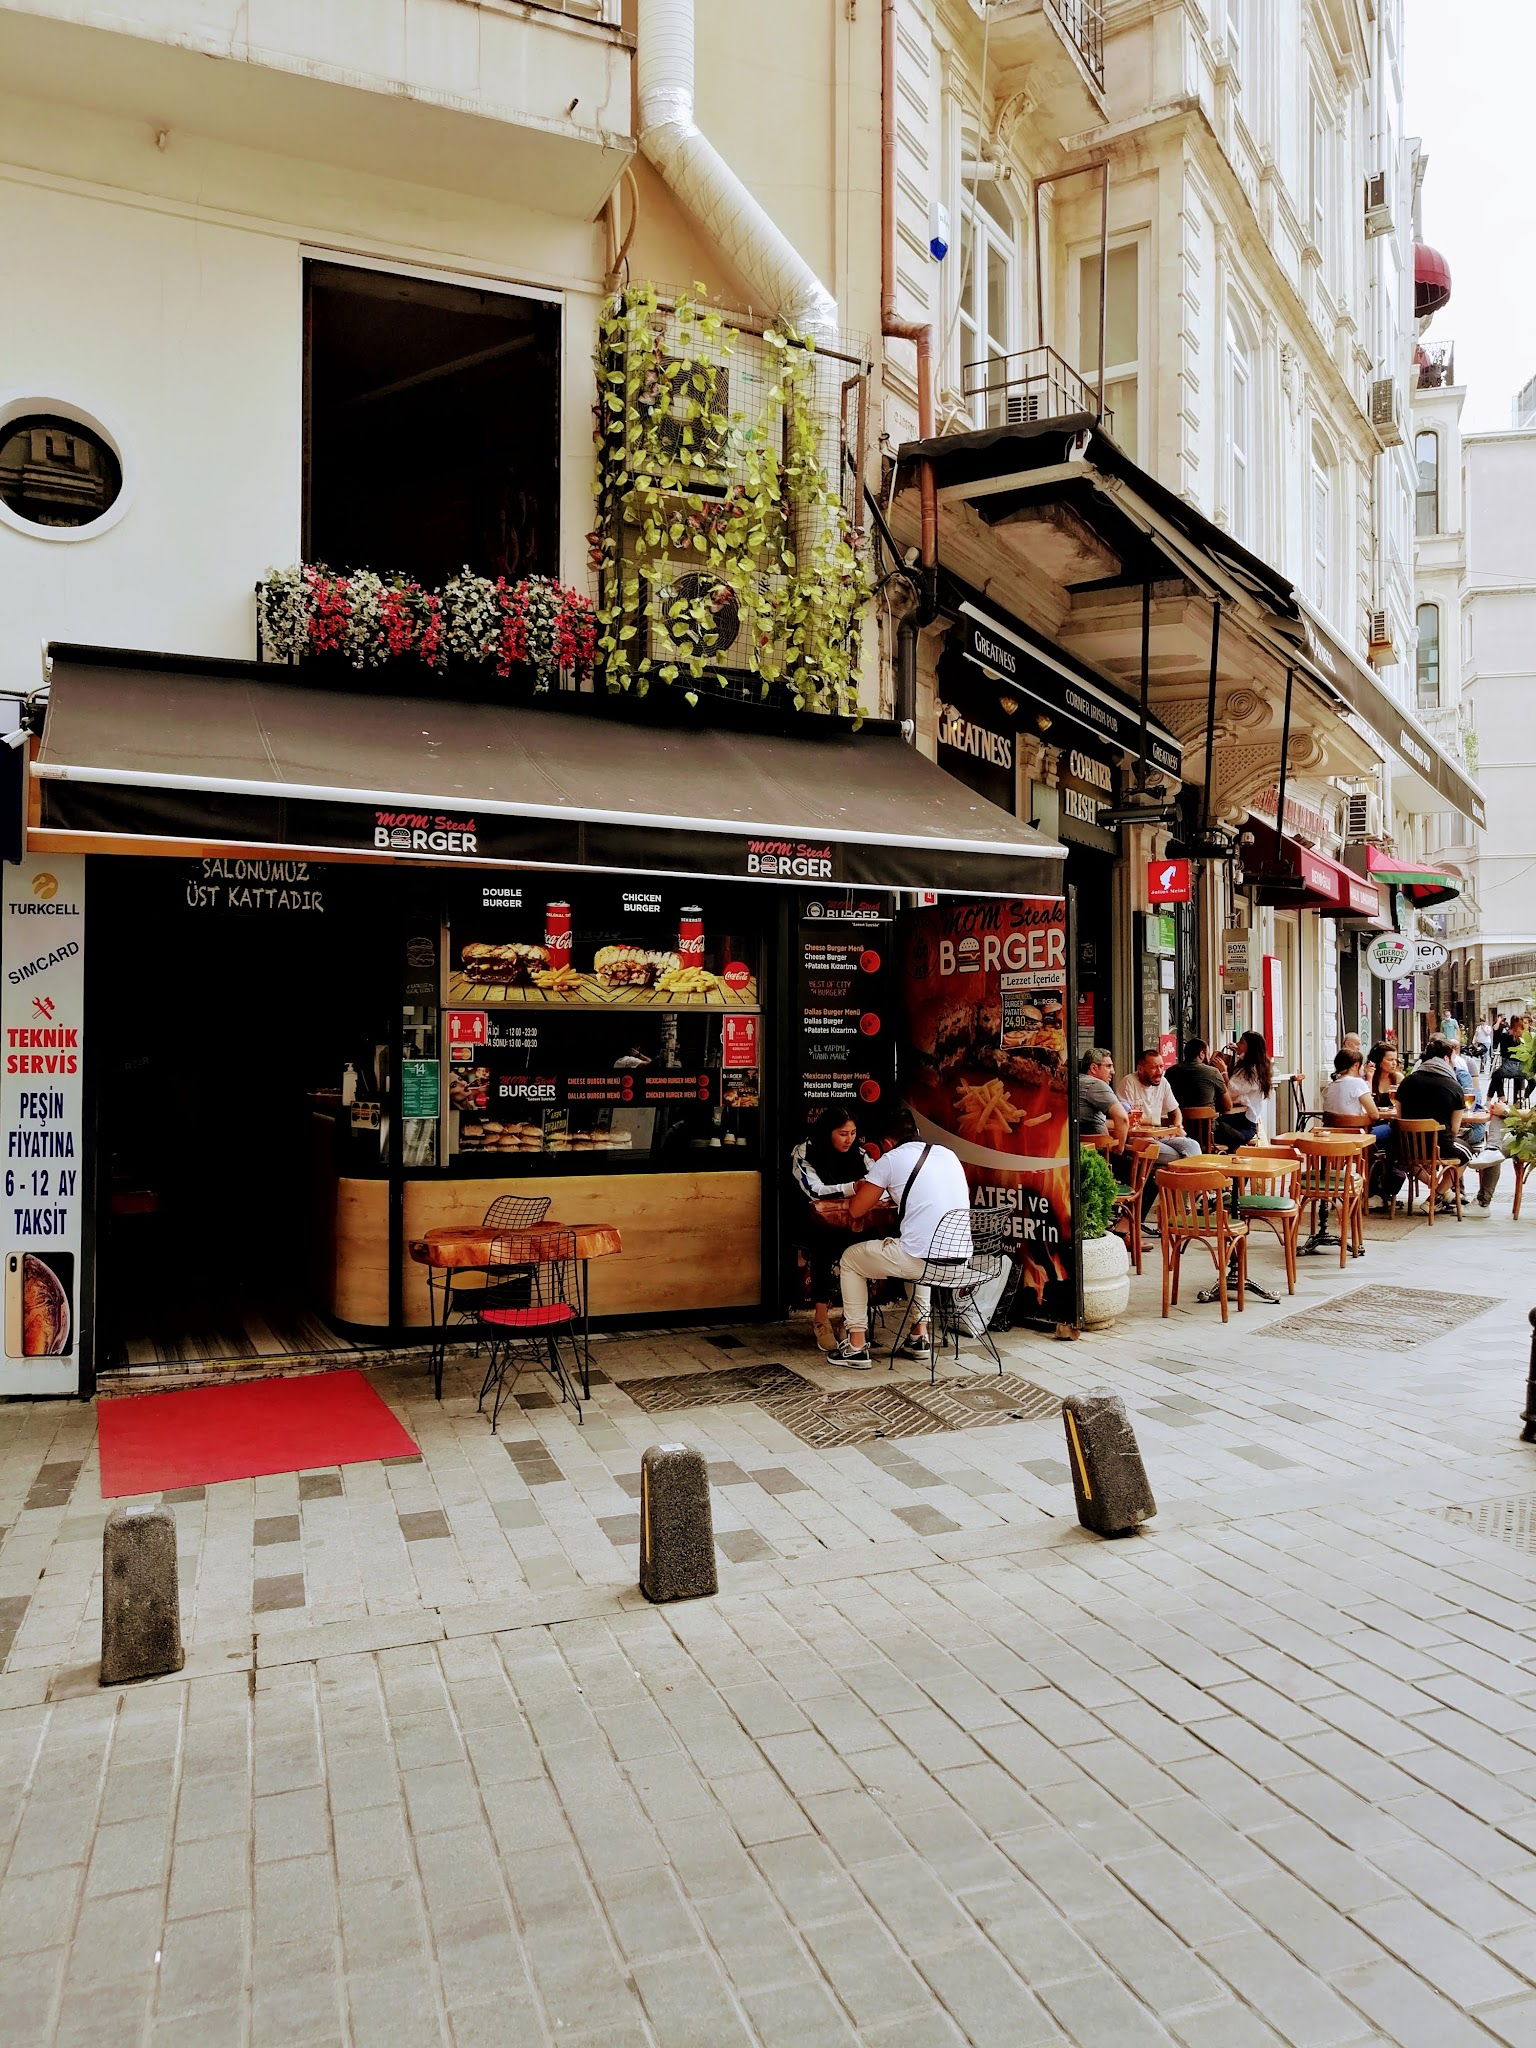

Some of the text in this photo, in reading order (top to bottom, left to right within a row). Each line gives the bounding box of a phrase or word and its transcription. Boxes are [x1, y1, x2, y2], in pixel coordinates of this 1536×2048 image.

[975, 630, 1016, 673] GREATNESS
[1065, 689, 1118, 732] CORNER IRISH PUB
[937, 711, 1012, 769] GREATNESS
[1152, 742, 1179, 770] GREATNESS
[1070, 749, 1112, 792] CORNER
[1065, 788, 1096, 825] IRISH
[434, 816, 477, 832] Steak
[795, 843, 832, 858] Steak
[202, 858, 309, 882] SALONUMUZ
[186, 880, 323, 913] ÜST KATTADIR
[482, 888, 522, 897] DOUBLE
[622, 893, 662, 903] CHICKEN
[9, 903, 80, 915] TURKCELL
[482, 898, 522, 908] BURGER
[623, 903, 661, 913] BURGER
[1009, 901, 1063, 928] Steak
[826, 953, 847, 961] Burger
[1376, 950, 1405, 958] GIDEROS
[8, 941, 80, 985] SIMCARD
[1426, 960, 1441, 970] BAR
[1006, 972, 1060, 986] Lezzet İçeride
[823, 1008, 843, 1016] Burger
[1004, 1008, 1026, 1016] PATATES
[803, 1017, 843, 1026] Dallas Burger
[1004, 1016, 1026, 1028] 24,90
[7, 1023, 78, 1047] TEKNİK
[804, 1026, 857, 1034] +Patates Kızartma
[7, 1049, 78, 1073] SERVİS
[832, 1072, 853, 1080] Burger
[499, 1084, 556, 1097] BURGER
[832, 1082, 853, 1090] Burger
[20, 1085, 64, 1127] PEŞİN
[9, 1124, 75, 1158] FİYATINA
[5, 1169, 15, 1197] 6
[31, 1169, 49, 1196] 12
[58, 1169, 77, 1196] AY
[1029, 1196, 1049, 1214] ve
[14, 1202, 67, 1235] TAKSİT
